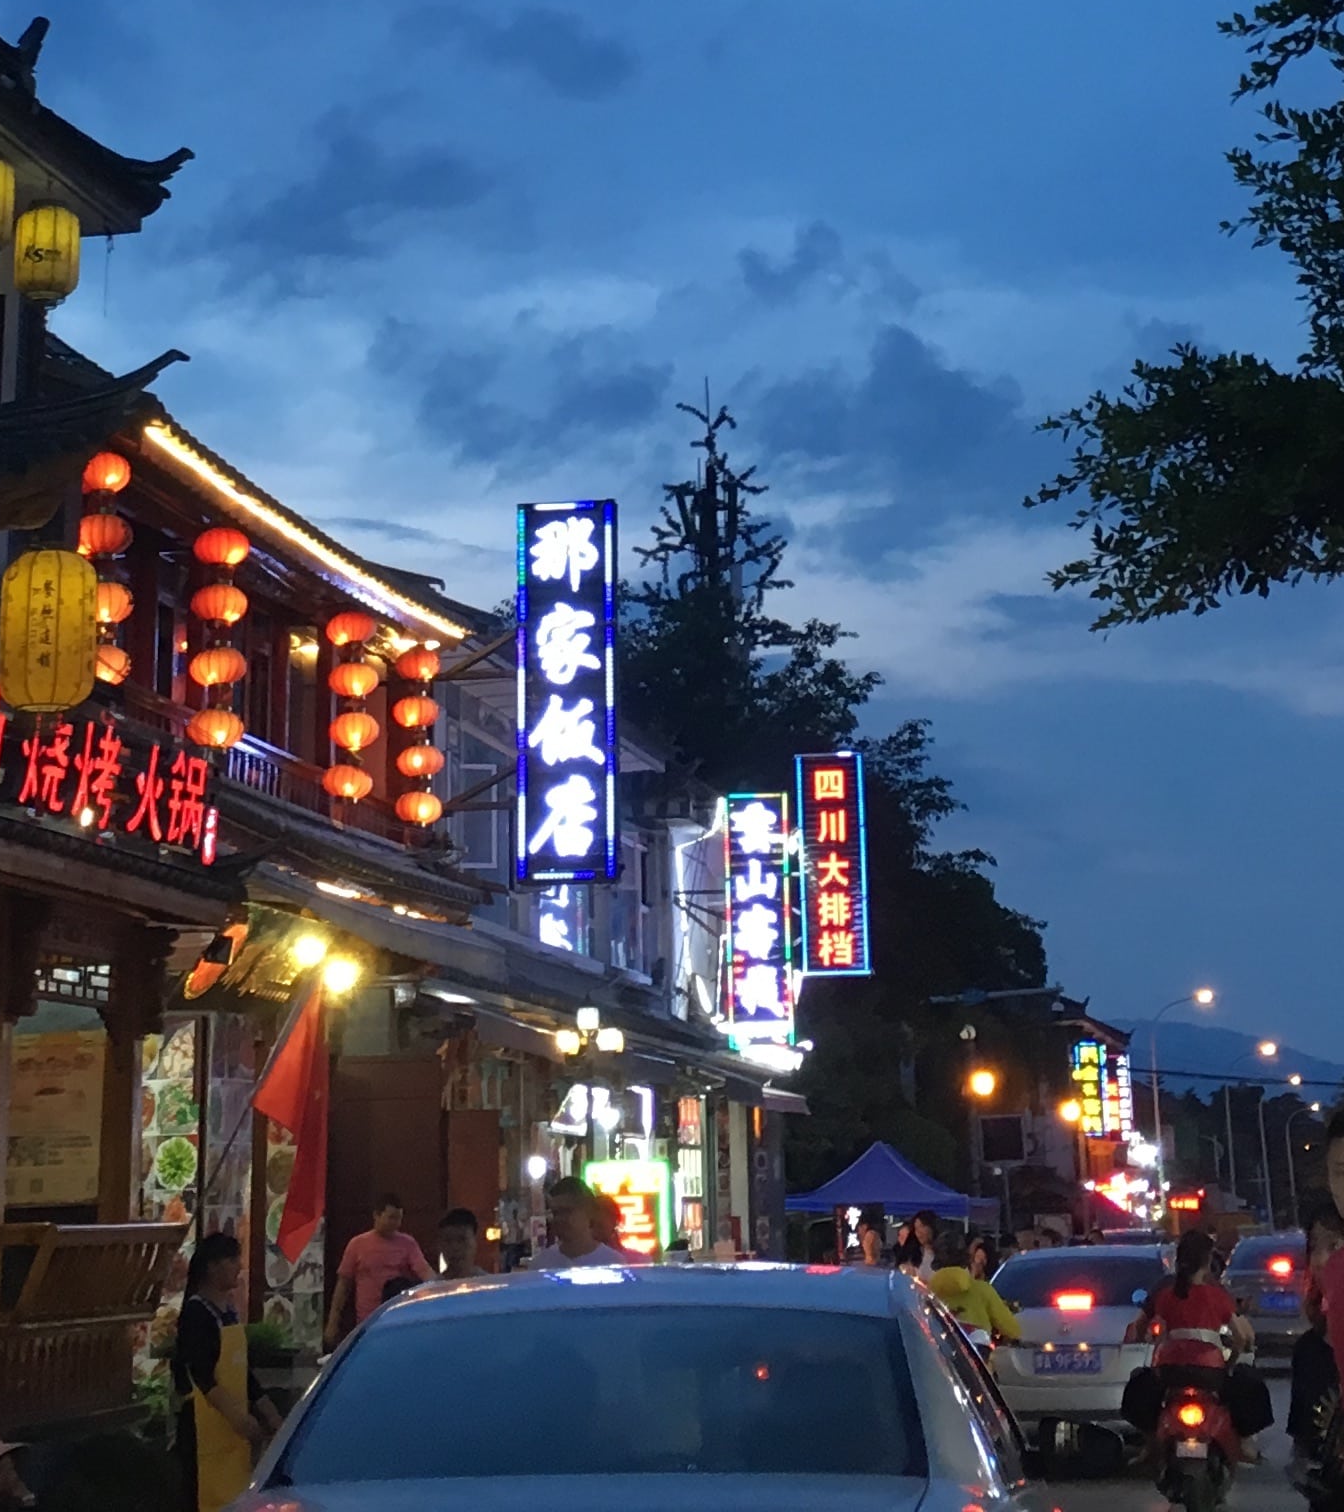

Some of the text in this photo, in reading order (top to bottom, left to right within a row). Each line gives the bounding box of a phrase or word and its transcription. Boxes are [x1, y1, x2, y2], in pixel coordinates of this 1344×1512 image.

[18, 721, 122, 829] 烧烤
[126, 743, 207, 848] 火锅
[814, 769, 855, 967] 四川大排档
